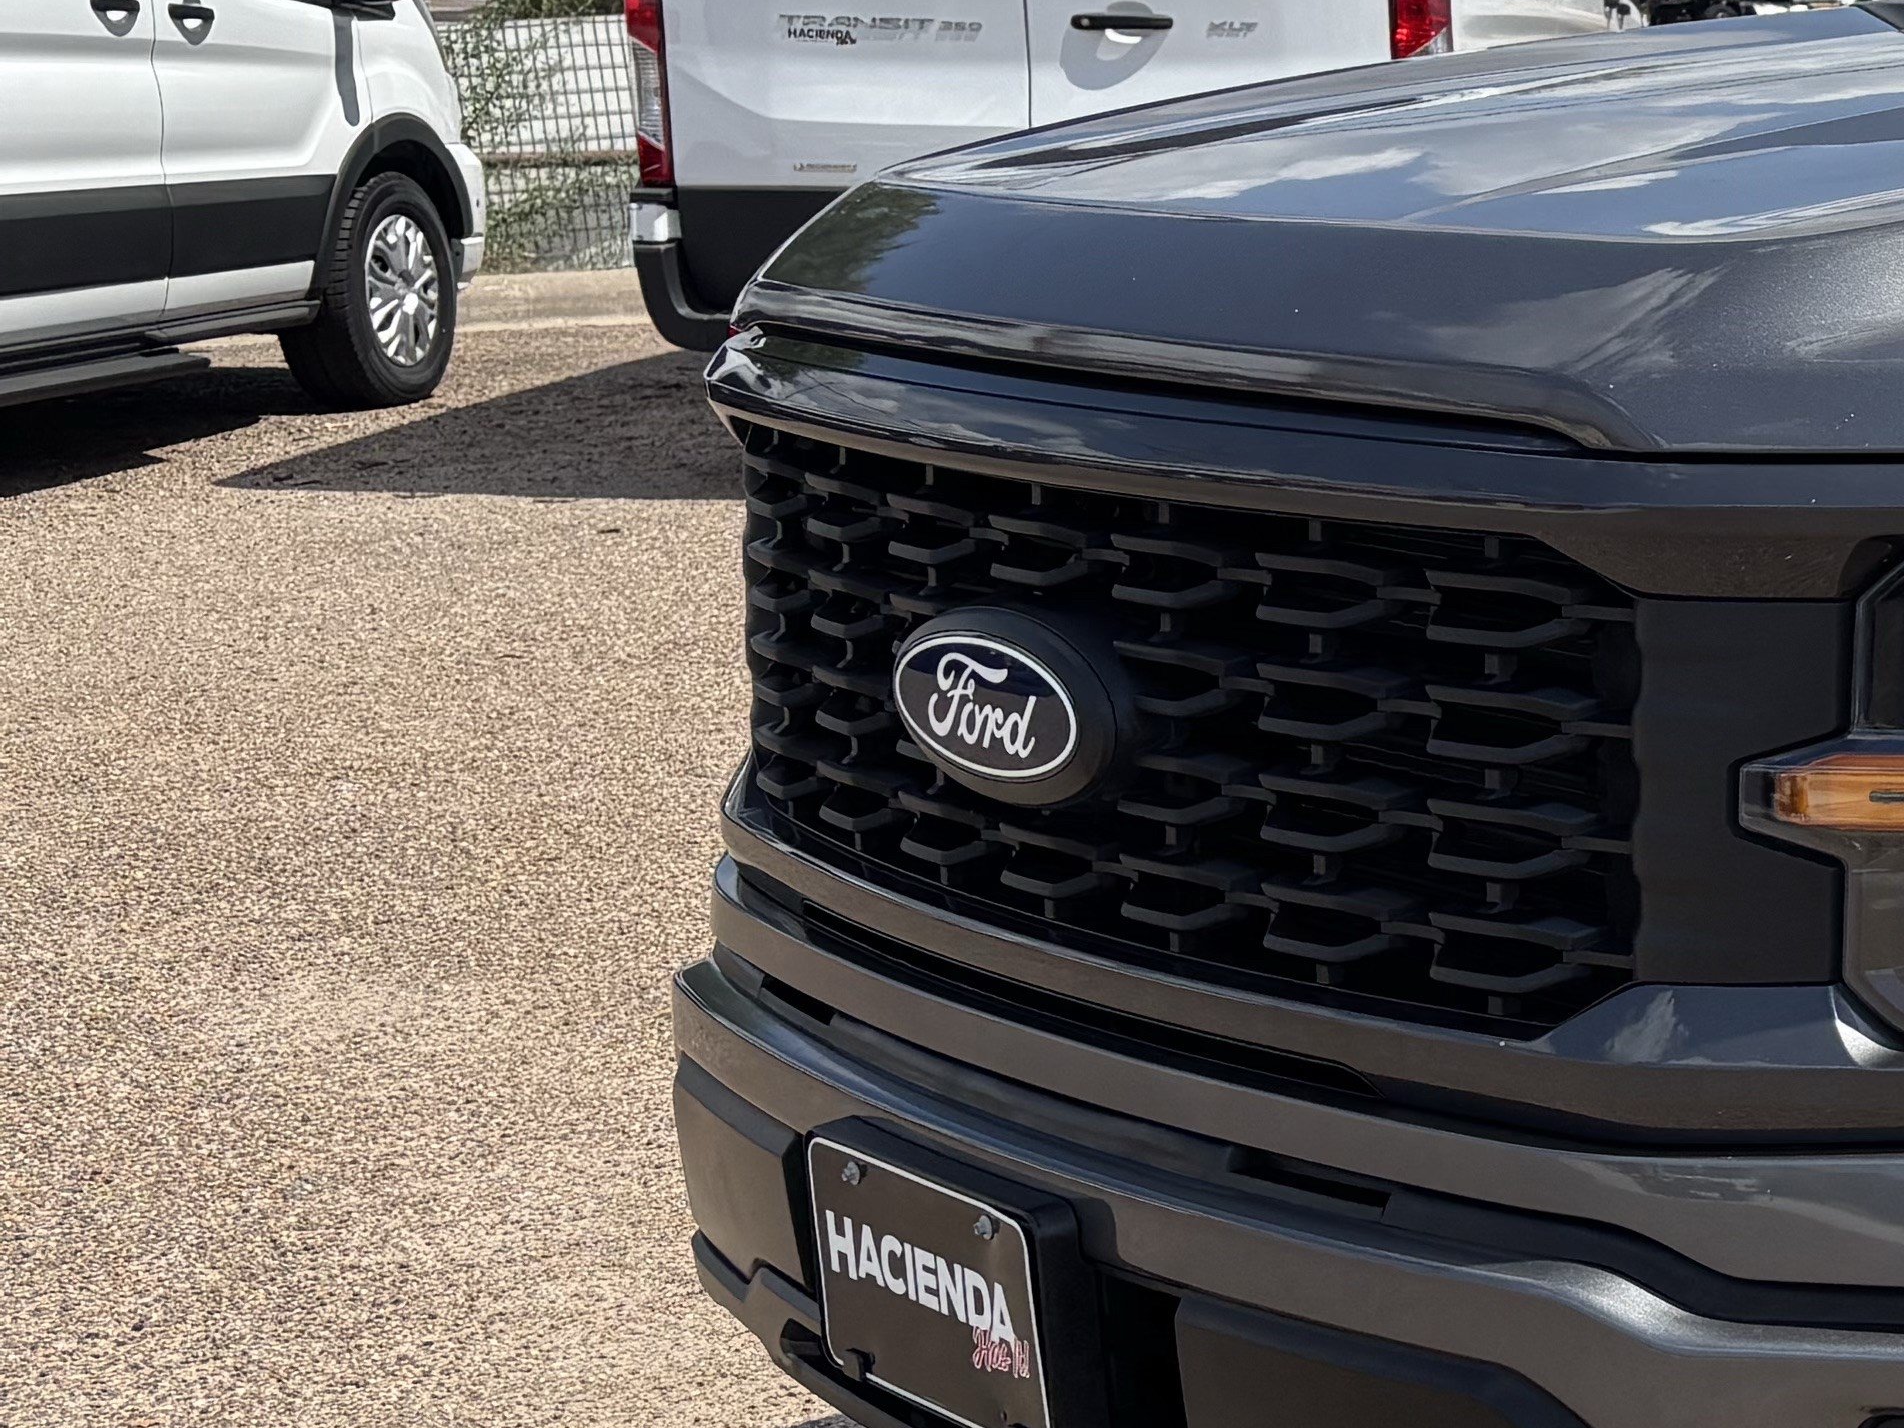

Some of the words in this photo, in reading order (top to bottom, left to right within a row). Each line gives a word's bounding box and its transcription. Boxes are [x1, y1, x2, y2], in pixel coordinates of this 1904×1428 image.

[779, 14, 936, 30] TRANSIT
[787, 28, 853, 41] HACIENDA
[927, 652, 1037, 759] Ford
[825, 1209, 1017, 1344] HACIENDA
